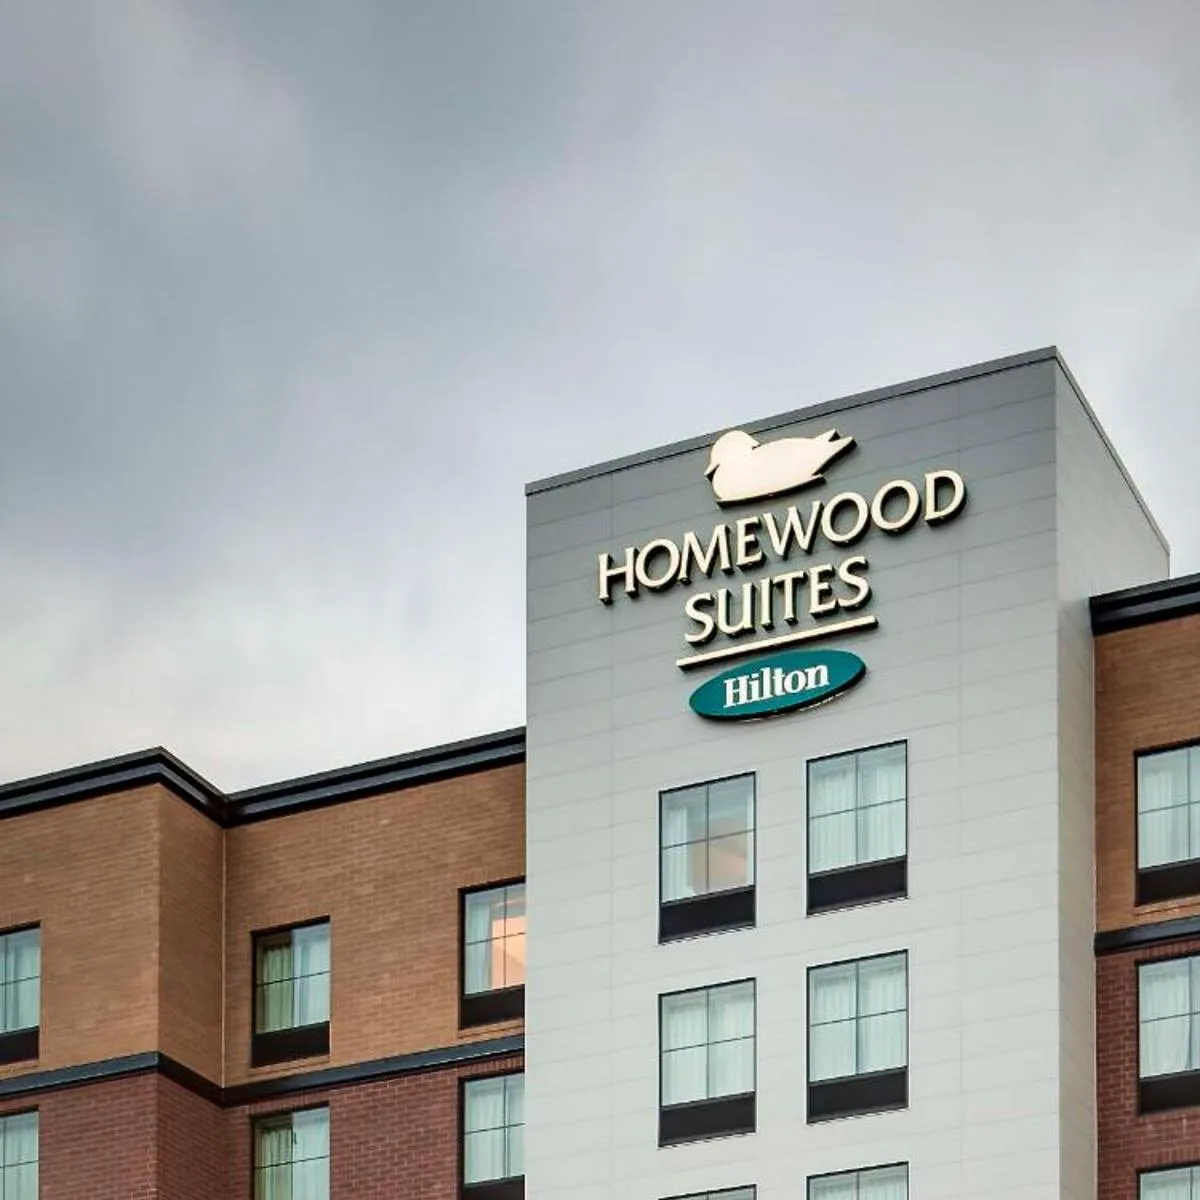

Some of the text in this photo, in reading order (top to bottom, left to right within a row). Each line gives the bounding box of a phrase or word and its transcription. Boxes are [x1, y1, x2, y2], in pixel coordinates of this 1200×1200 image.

[597, 469, 967, 604] HOMEWOOD
[684, 555, 873, 646] SUITES
[722, 663, 829, 708] Hilton
